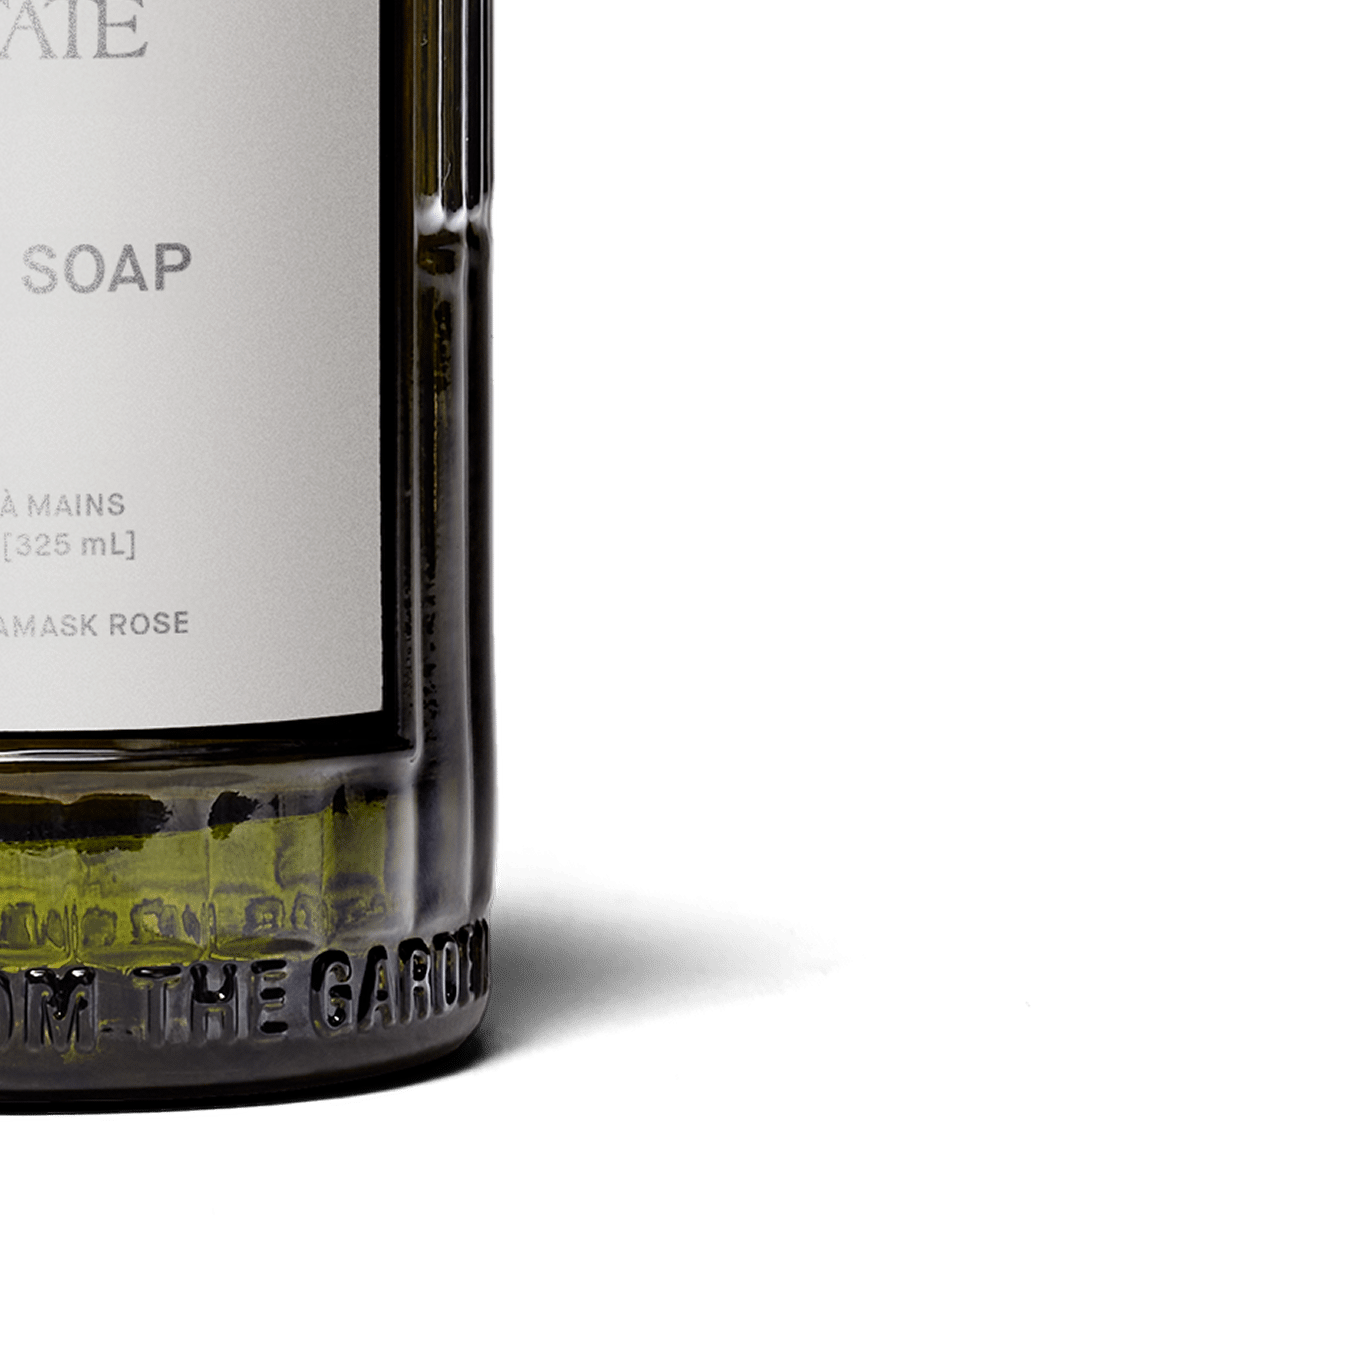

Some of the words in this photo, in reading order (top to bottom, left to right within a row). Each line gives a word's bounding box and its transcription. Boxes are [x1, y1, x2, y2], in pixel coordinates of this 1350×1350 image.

[21, 242, 192, 294] SOAP
[0, 489, 18, 517] À
[27, 492, 125, 517] MAINS
[3, 532, 71, 562] [325
[81, 530, 136, 561] mL]
[109, 610, 189, 637] ROSE
[132, 958, 290, 1046] THE
